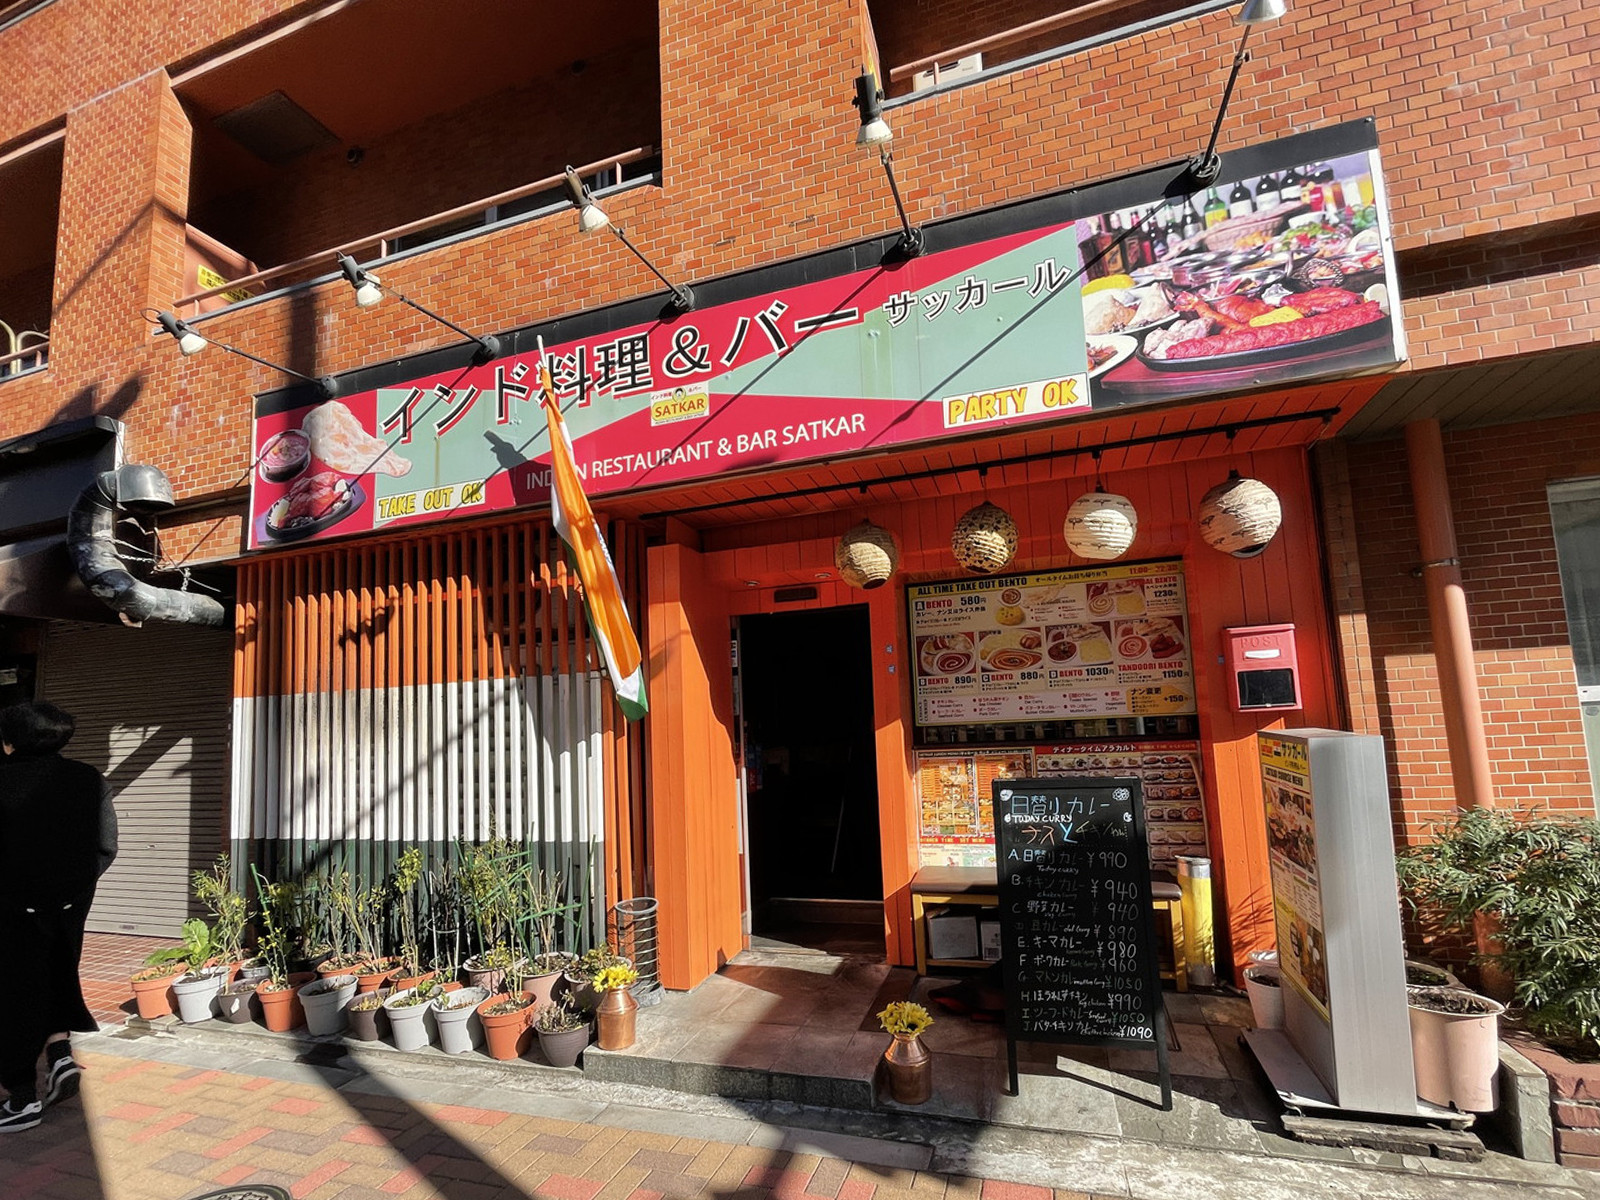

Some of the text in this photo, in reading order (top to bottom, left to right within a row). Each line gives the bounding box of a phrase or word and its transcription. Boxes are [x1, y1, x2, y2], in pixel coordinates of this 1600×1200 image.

[882, 257, 1072, 327] サッカール
[655, 398, 705, 418] SATKAR
[949, 378, 1079, 425] PARTY OK
[592, 441, 713, 478] RESTAURANT
[717, 437, 733, 457] &
[737, 429, 778, 453] BAR
[782, 413, 866, 445] SATKAR
[379, 481, 483, 518] TAKE OUT OK
[918, 578, 1027, 595] ALL TIME TAKE OUT BENTO
[926, 599, 952, 609] BENTO
[1241, 634, 1281, 648] POST
[1118, 661, 1183, 672] TANDOORI BENTO
[1053, 745, 1136, 754] ディナータイムアラカルト
[1011, 815, 1073, 823] TODAY CURRY
[1033, 935, 1083, 948] キーマカレー
[1097, 940, 1137, 959] ¥980
[1119, 1025, 1153, 1039] ¥1090
